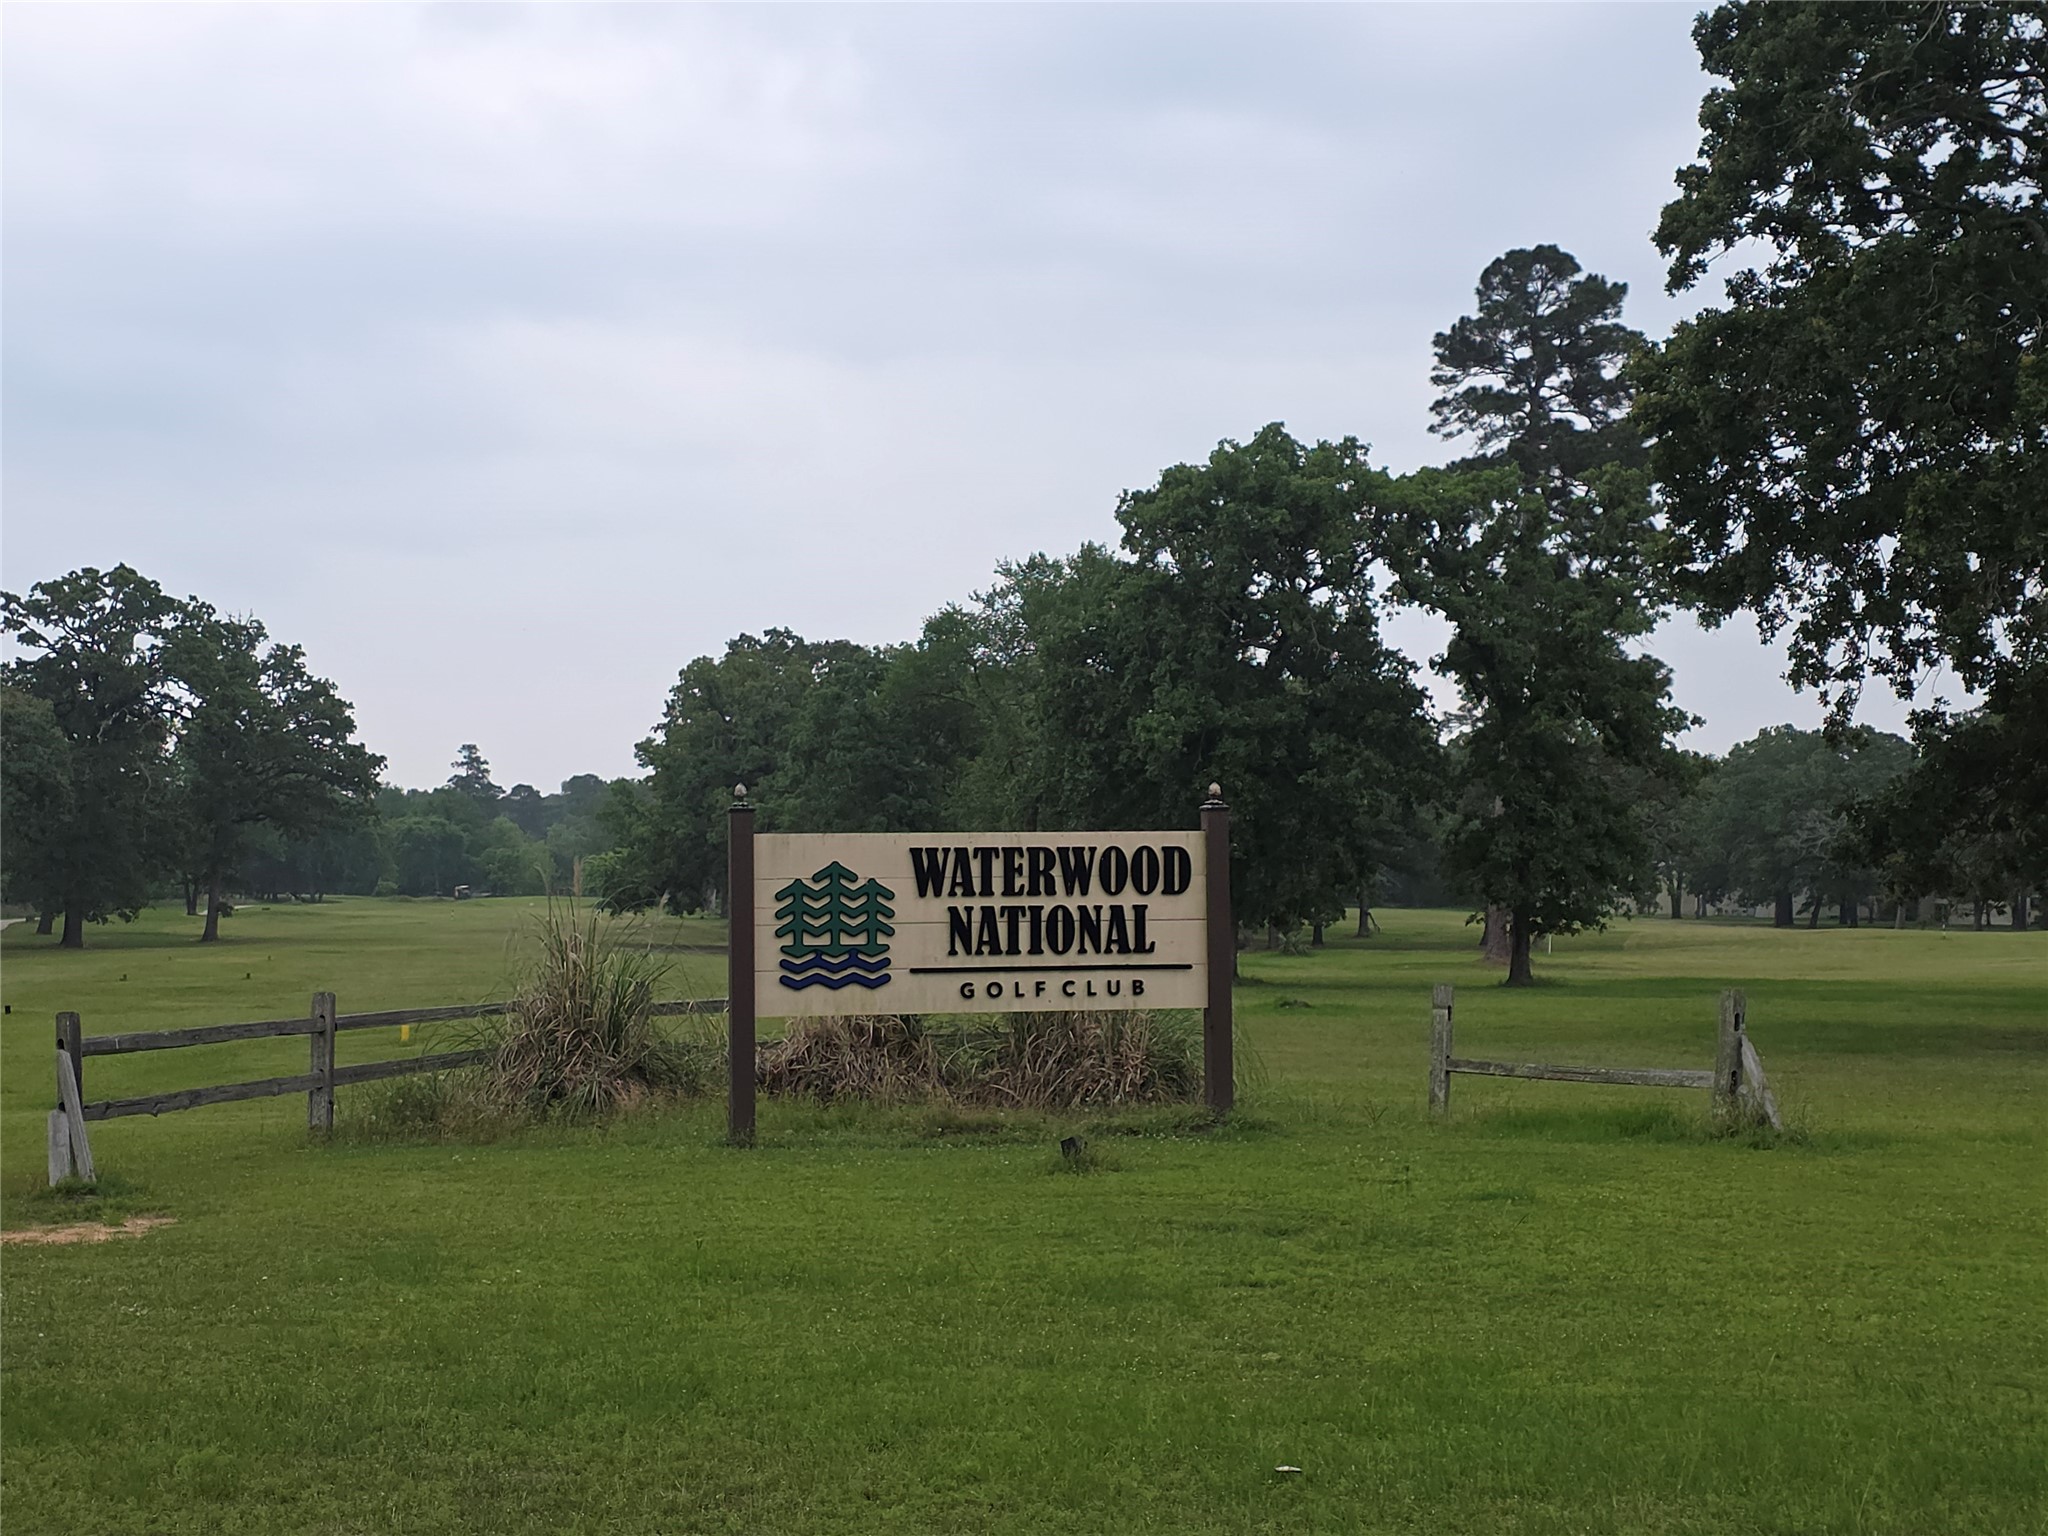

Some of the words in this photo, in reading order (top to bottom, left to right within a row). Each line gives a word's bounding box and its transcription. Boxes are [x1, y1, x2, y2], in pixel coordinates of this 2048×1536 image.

[909, 845, 1192, 898] WATERWOOD
[948, 904, 1156, 956] NATIONAL
[960, 980, 1046, 999] GOLF
[1062, 979, 1145, 997] CLUB
